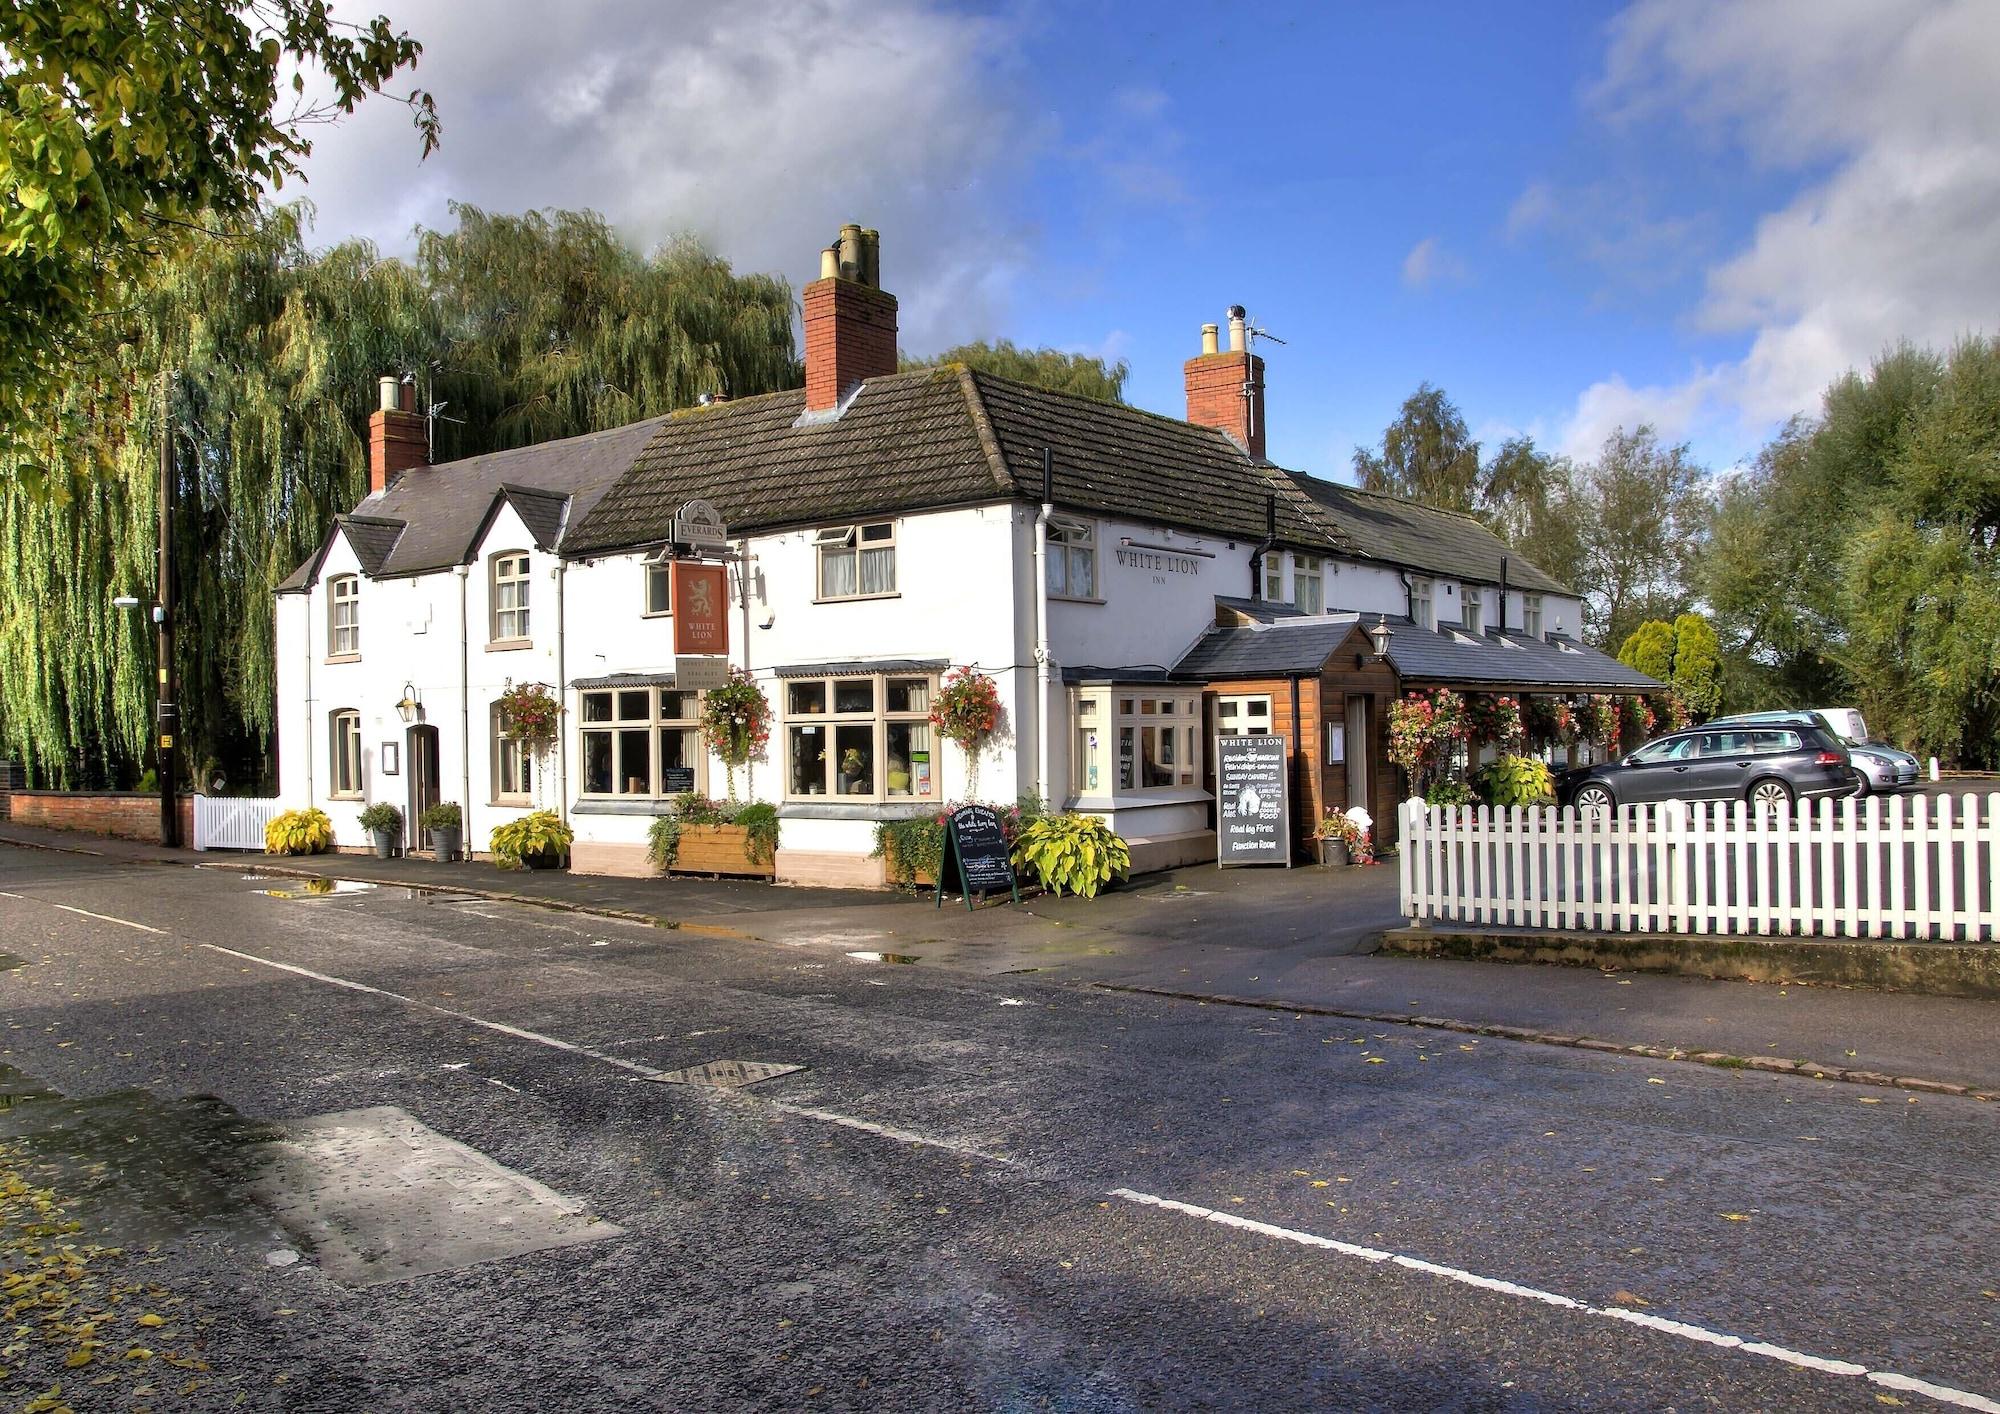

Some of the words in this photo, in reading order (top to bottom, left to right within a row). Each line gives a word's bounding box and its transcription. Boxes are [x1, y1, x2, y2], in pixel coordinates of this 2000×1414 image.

[680, 524, 723, 540] EVERARDS
[1116, 550, 1162, 571] WHITE
[1168, 557, 1198, 576] LION
[1152, 576, 1166, 585] INN
[688, 622, 716, 631] WHITE
[692, 631, 713, 639] LION
[1258, 738, 1282, 746] LION
